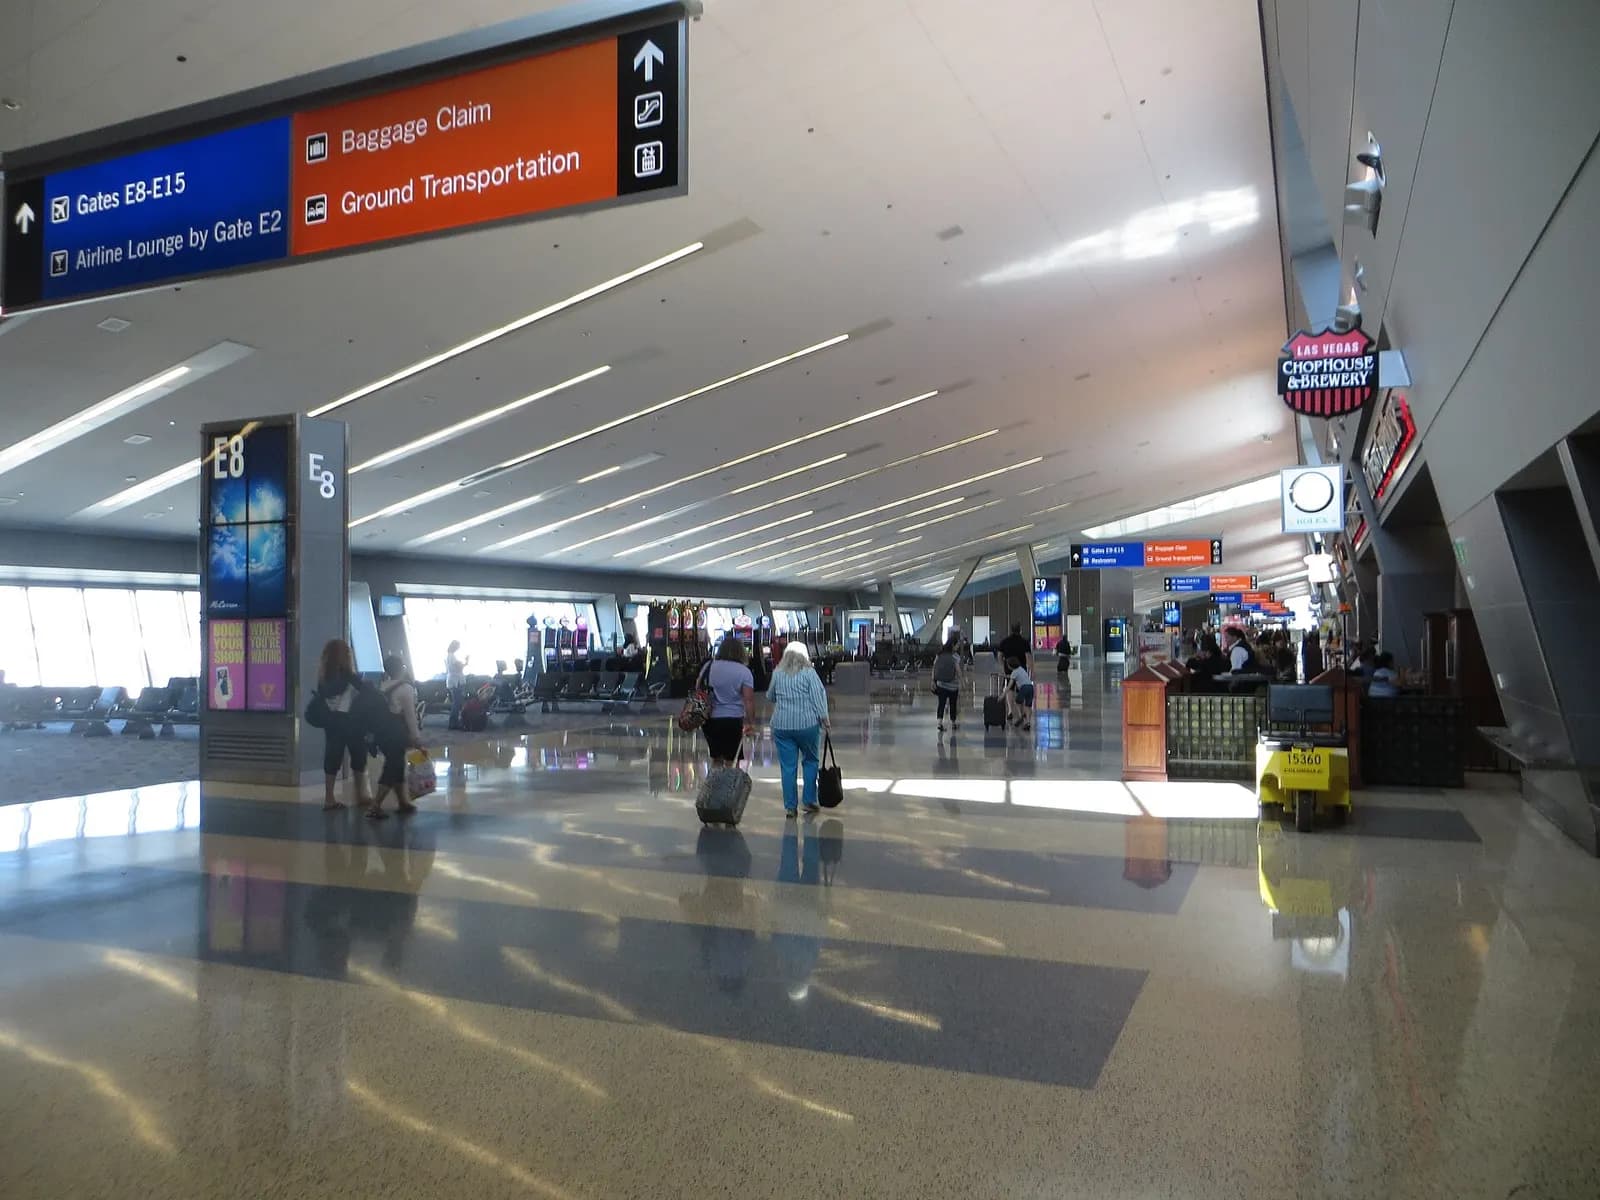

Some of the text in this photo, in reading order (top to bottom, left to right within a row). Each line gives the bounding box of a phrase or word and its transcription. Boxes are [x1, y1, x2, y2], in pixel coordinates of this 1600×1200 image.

[342, 101, 491, 153] Baggage Claim
[341, 150, 580, 215] Ground Transportation
[77, 172, 186, 215] Gates E8-E15
[76, 210, 282, 270] Airline Lounge by Gate E2
[1297, 342, 1359, 356] LAS VEGAS
[1282, 356, 1374, 375] CHOPHOUSE
[214, 434, 244, 480] E8
[1034, 578, 1047, 592] E9
[252, 622, 281, 636] WHILE
[214, 638, 244, 650] YOUR
[214, 650, 245, 664] SHOW
[252, 650, 282, 664] WAITING
[1288, 754, 1321, 765] 15360
